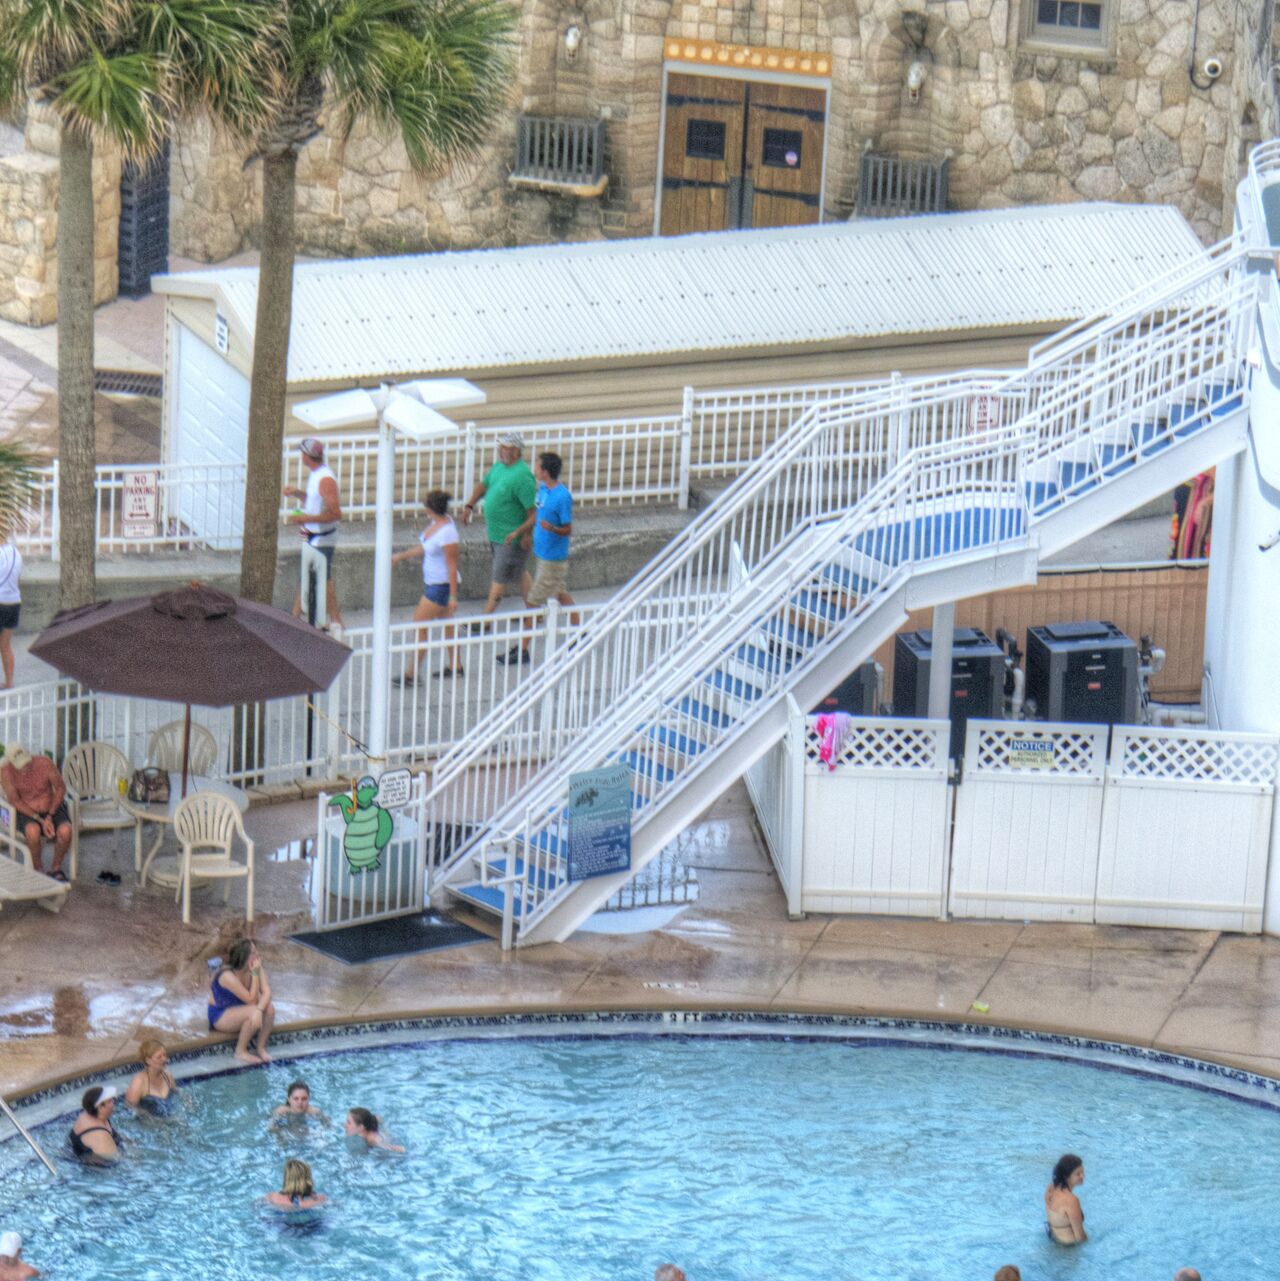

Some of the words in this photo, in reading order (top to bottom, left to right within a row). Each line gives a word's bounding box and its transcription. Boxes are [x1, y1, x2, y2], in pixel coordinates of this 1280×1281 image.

[133, 475, 147, 485] NO
[125, 486, 155, 496] PARKING
[1014, 740, 1052, 752] NOTICE
[683, 1012, 701, 1023] FT
